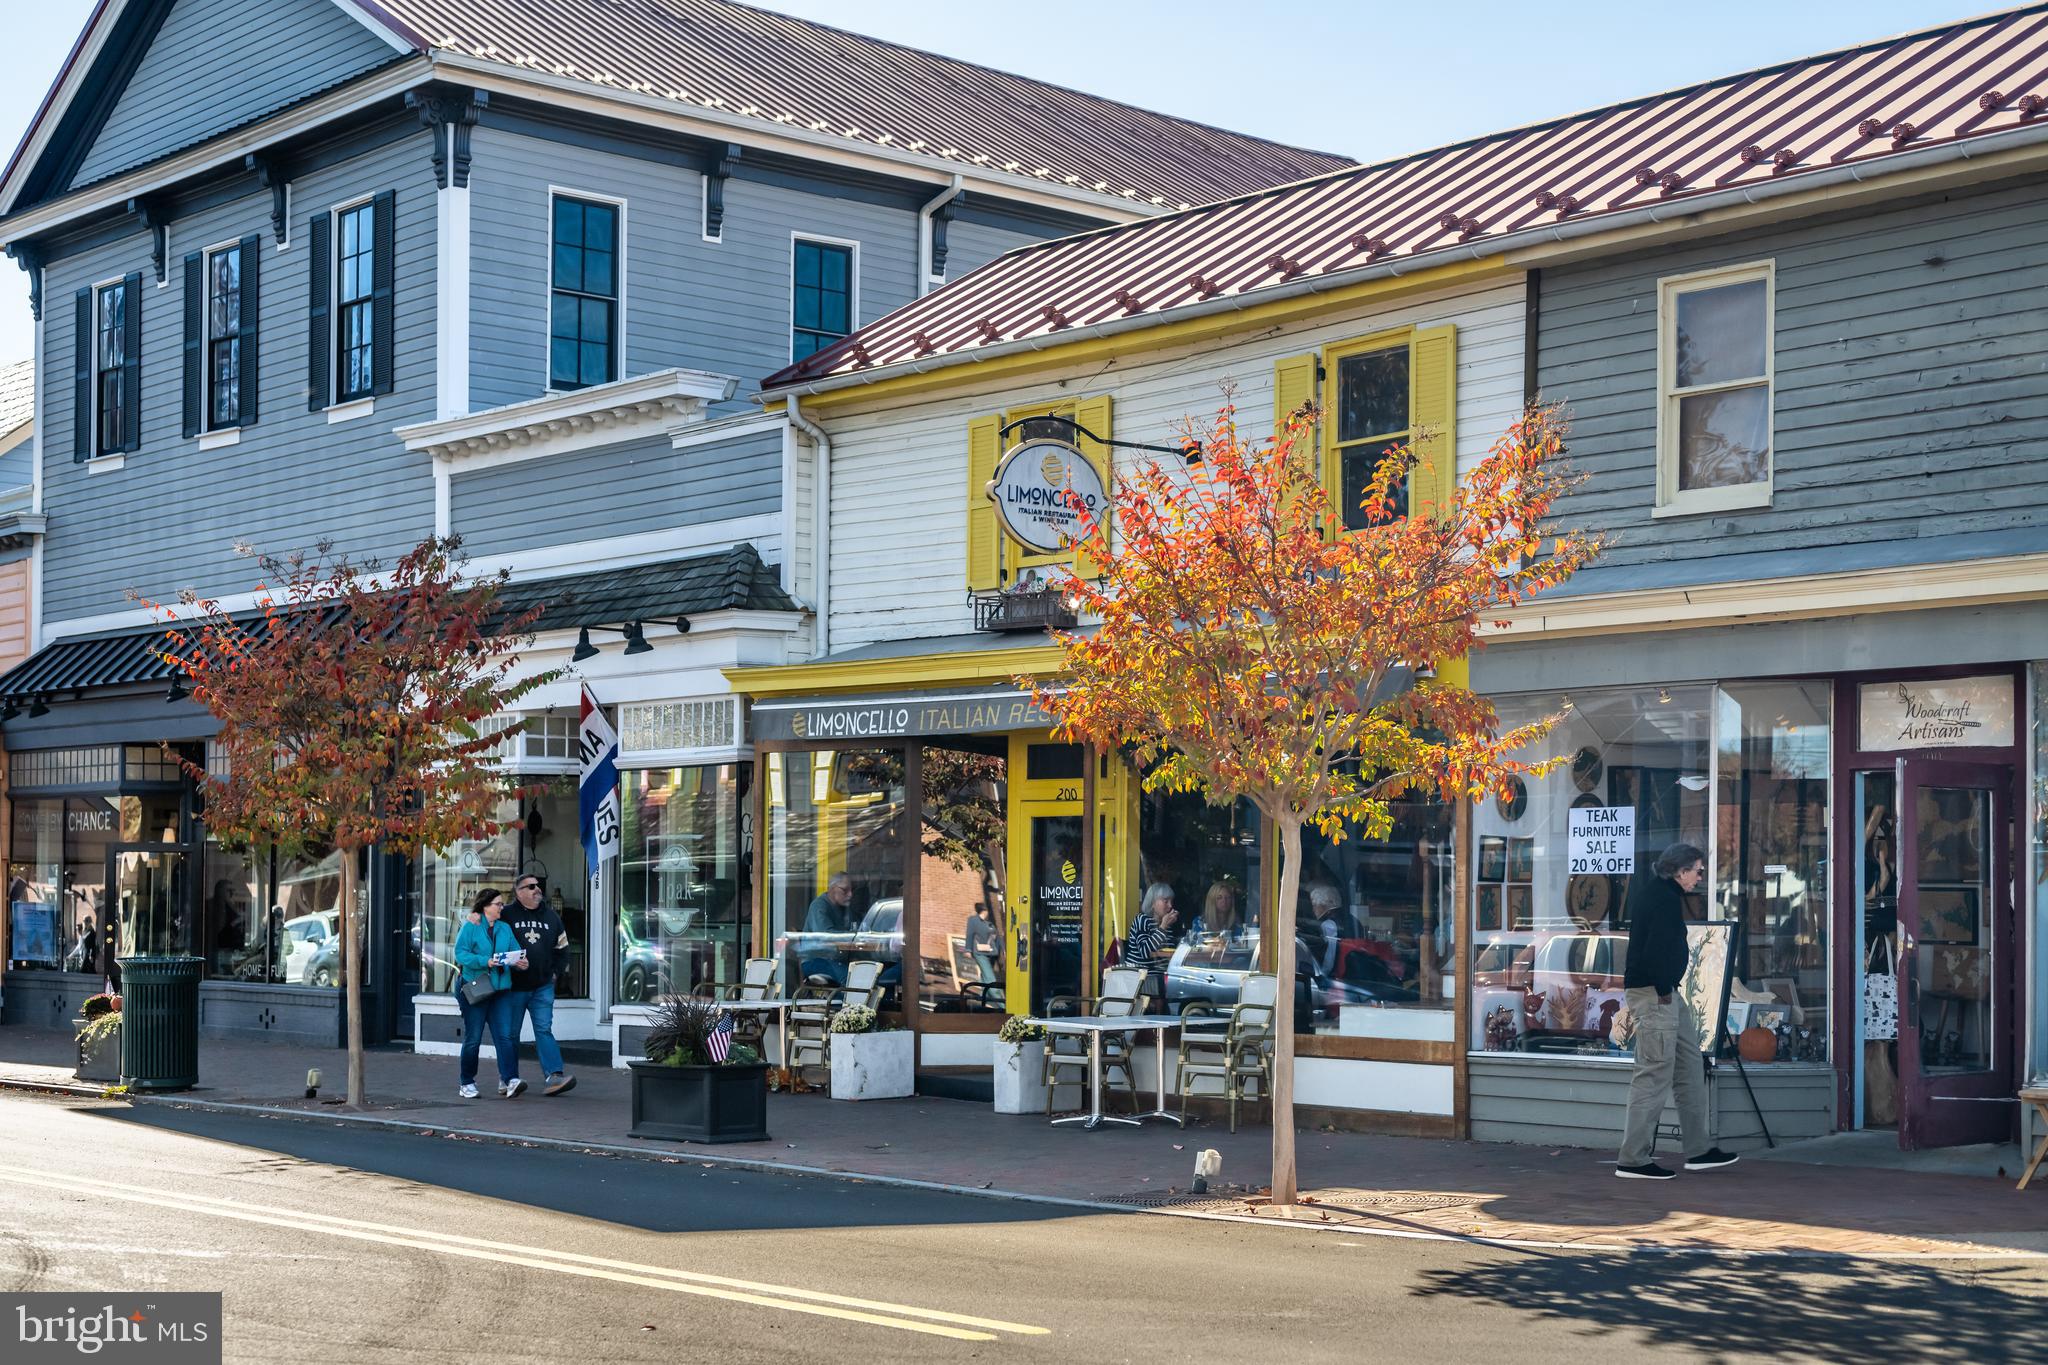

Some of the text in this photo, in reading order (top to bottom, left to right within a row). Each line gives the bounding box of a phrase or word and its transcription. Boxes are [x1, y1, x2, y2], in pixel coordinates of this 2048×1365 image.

[1018, 507, 1078, 519] ITALIAN RESTAURA
[1904, 700, 1971, 720] Woodcraft
[808, 703, 1051, 737] LIMONCELLO ITALIAN RES
[1898, 722, 1965, 740] Artisans
[1056, 788, 1078, 800] 200
[49, 812, 63, 832] BY
[68, 811, 112, 831] CHANCE
[1586, 809, 1618, 822] TEAK
[1573, 826, 1631, 837] FURNITURE
[1586, 841, 1617, 854] SALE
[1571, 858, 1632, 872] 20 % OFF
[514, 920, 549, 930] SAINTS
[243, 964, 262, 977] HOME
